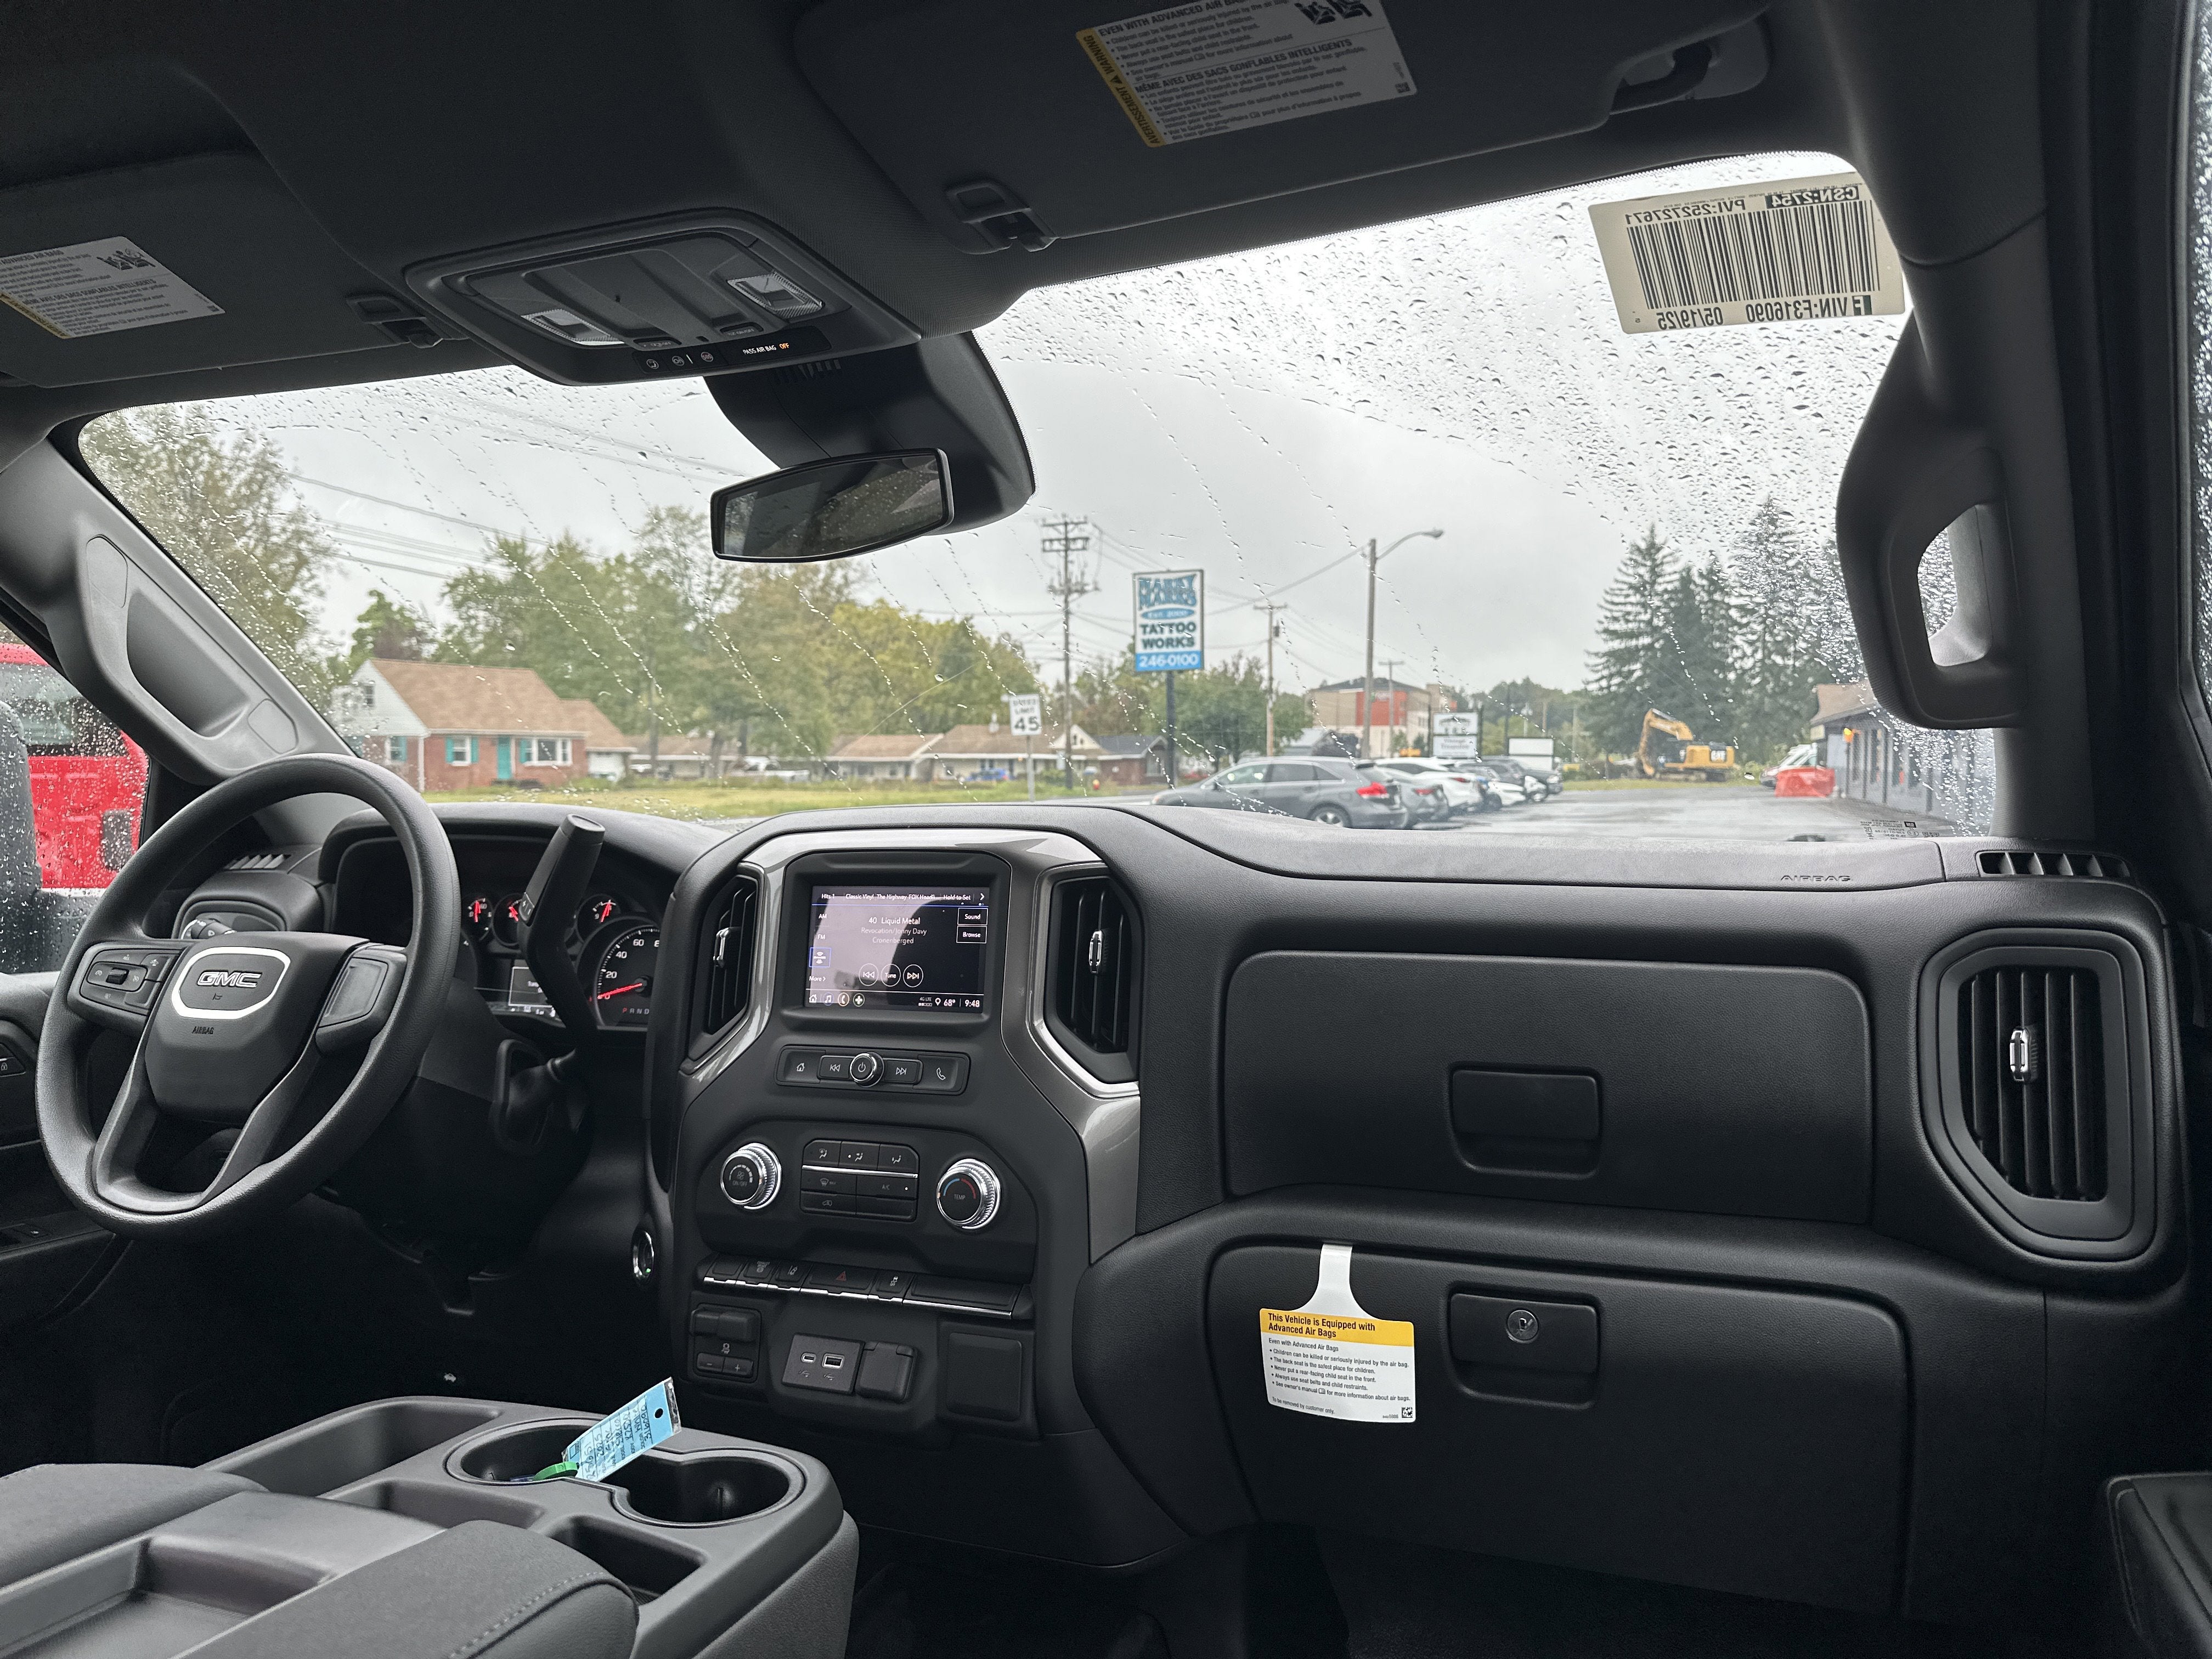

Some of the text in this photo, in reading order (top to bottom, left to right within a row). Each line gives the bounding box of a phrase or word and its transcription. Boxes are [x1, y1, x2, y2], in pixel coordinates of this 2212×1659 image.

[1098, 25, 1123, 36] EVEN
[1124, 18, 1149, 29] WITH
[1152, 4, 1203, 22] ADVANCED
[1205, 0, 1222, 10] AIR
[1083, 35, 1115, 75] WARNING
[1163, 75, 1185, 86] AVEC
[1186, 71, 1203, 81] DES
[1204, 65, 1228, 77] SACS
[1229, 53, 1286, 71] GONFLABLES
[1288, 38, 1352, 59] INTELLIGENTS
[1116, 87, 1161, 144] AVERTISSEMENT
[1139, 621, 1197, 635] TATTOO
[1141, 636, 1195, 650] WORKS
[1139, 653, 1198, 668] 246-0100
[1014, 716, 1040, 731] 45
[881, 917, 901, 926] Liquid
[861, 927, 927, 936] Revocation/Jonny Davy
[872, 937, 914, 945] Cronenberged
[616, 951, 627, 959] 40
[197, 970, 263, 989] GMC
[605, 970, 617, 979] 20
[191, 1026, 214, 1035] AIRBAG
[1267, 1313, 1375, 1331] This Vehicle is Equipped with
[1268, 1322, 1336, 1339] Advanced Air Bags
[1293, 1341, 1316, 1349] Advanced
[1330, 1355, 1352, 1364] seriously
[1353, 1357, 1370, 1365] injured
[1299, 1369, 1324, 1378] rear-facing
[1347, 1391, 1374, 1400] information
